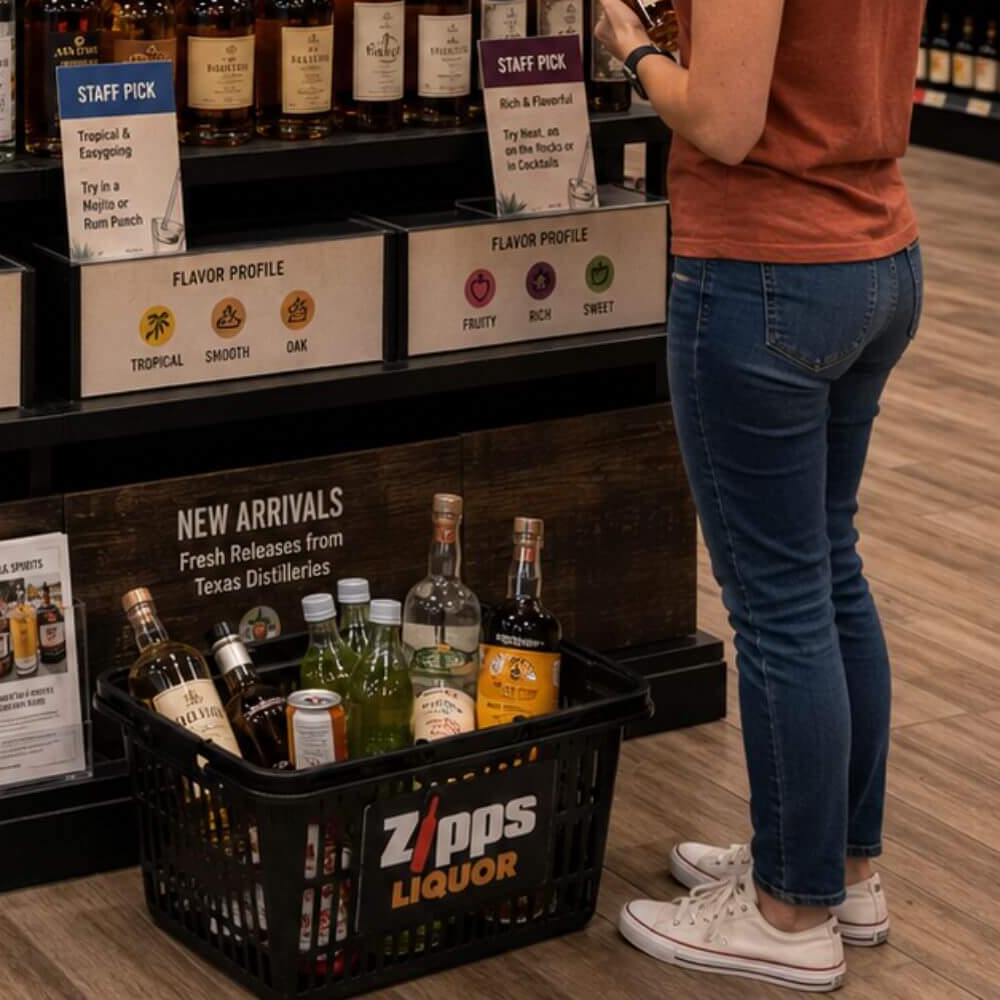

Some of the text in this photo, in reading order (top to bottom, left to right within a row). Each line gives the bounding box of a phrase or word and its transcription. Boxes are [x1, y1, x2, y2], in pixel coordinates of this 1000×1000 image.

[498, 53, 567, 73] STAFF PICK
[77, 82, 156, 103] STAFF PICK
[78, 128, 130, 142] Tropical &
[504, 129, 518, 142] Try
[81, 181, 119, 195] Try in a
[118, 199, 128, 209] or
[84, 214, 143, 229] Rum Punch
[492, 227, 588, 250] FLAVOR PROFILE
[173, 260, 285, 287] FLAVOR PROFILE
[463, 301, 614, 330] FRUITY RICH SWEET
[130, 339, 307, 372] TROPICAL SMOOTH OAK
[178, 487, 343, 541] NEW ARRIVALS
[180, 532, 343, 571] Fresh Releases from
[195, 560, 331, 596] Texas Distilleries
[391, 851, 519, 909] LIQUOR
